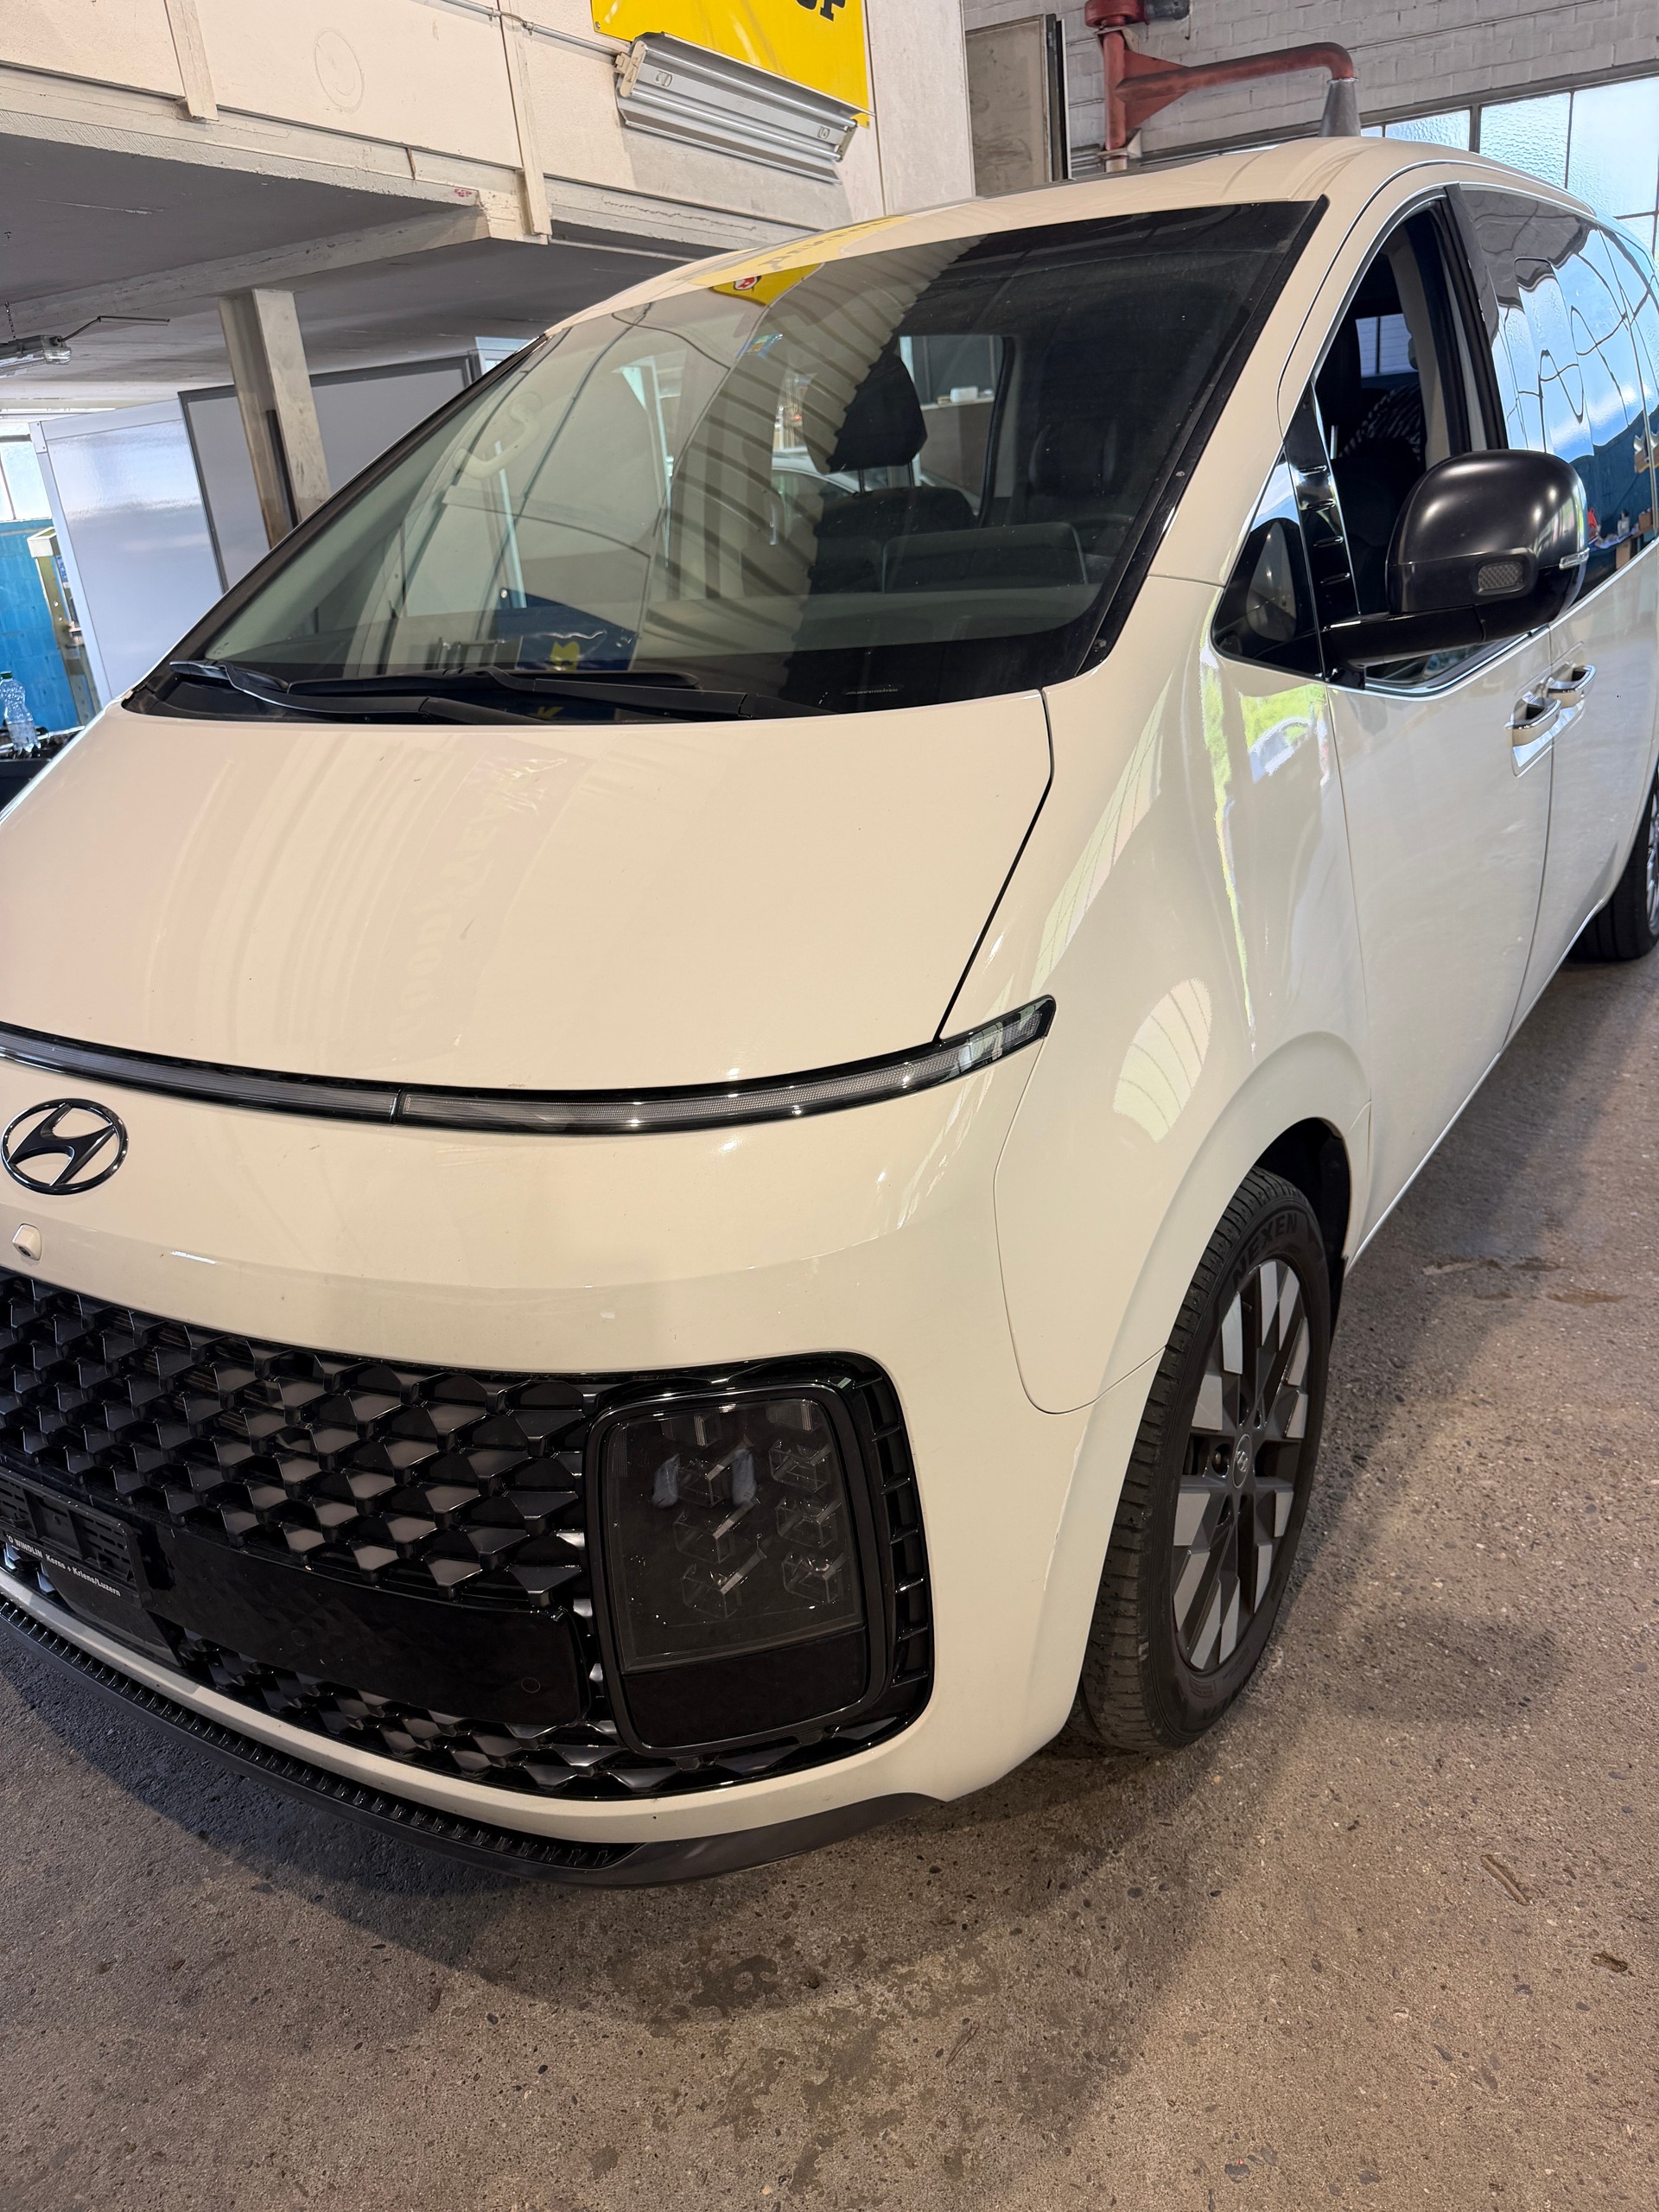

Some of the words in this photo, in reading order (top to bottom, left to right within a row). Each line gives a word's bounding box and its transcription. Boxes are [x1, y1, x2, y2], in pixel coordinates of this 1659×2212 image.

[1233, 1213, 1297, 1291] NEXEN
[14, 1538, 43, 1558] WINDLIN
[45, 1554, 66, 1569] Kerns
[72, 1567, 121, 1597] Kriens/Luzern
